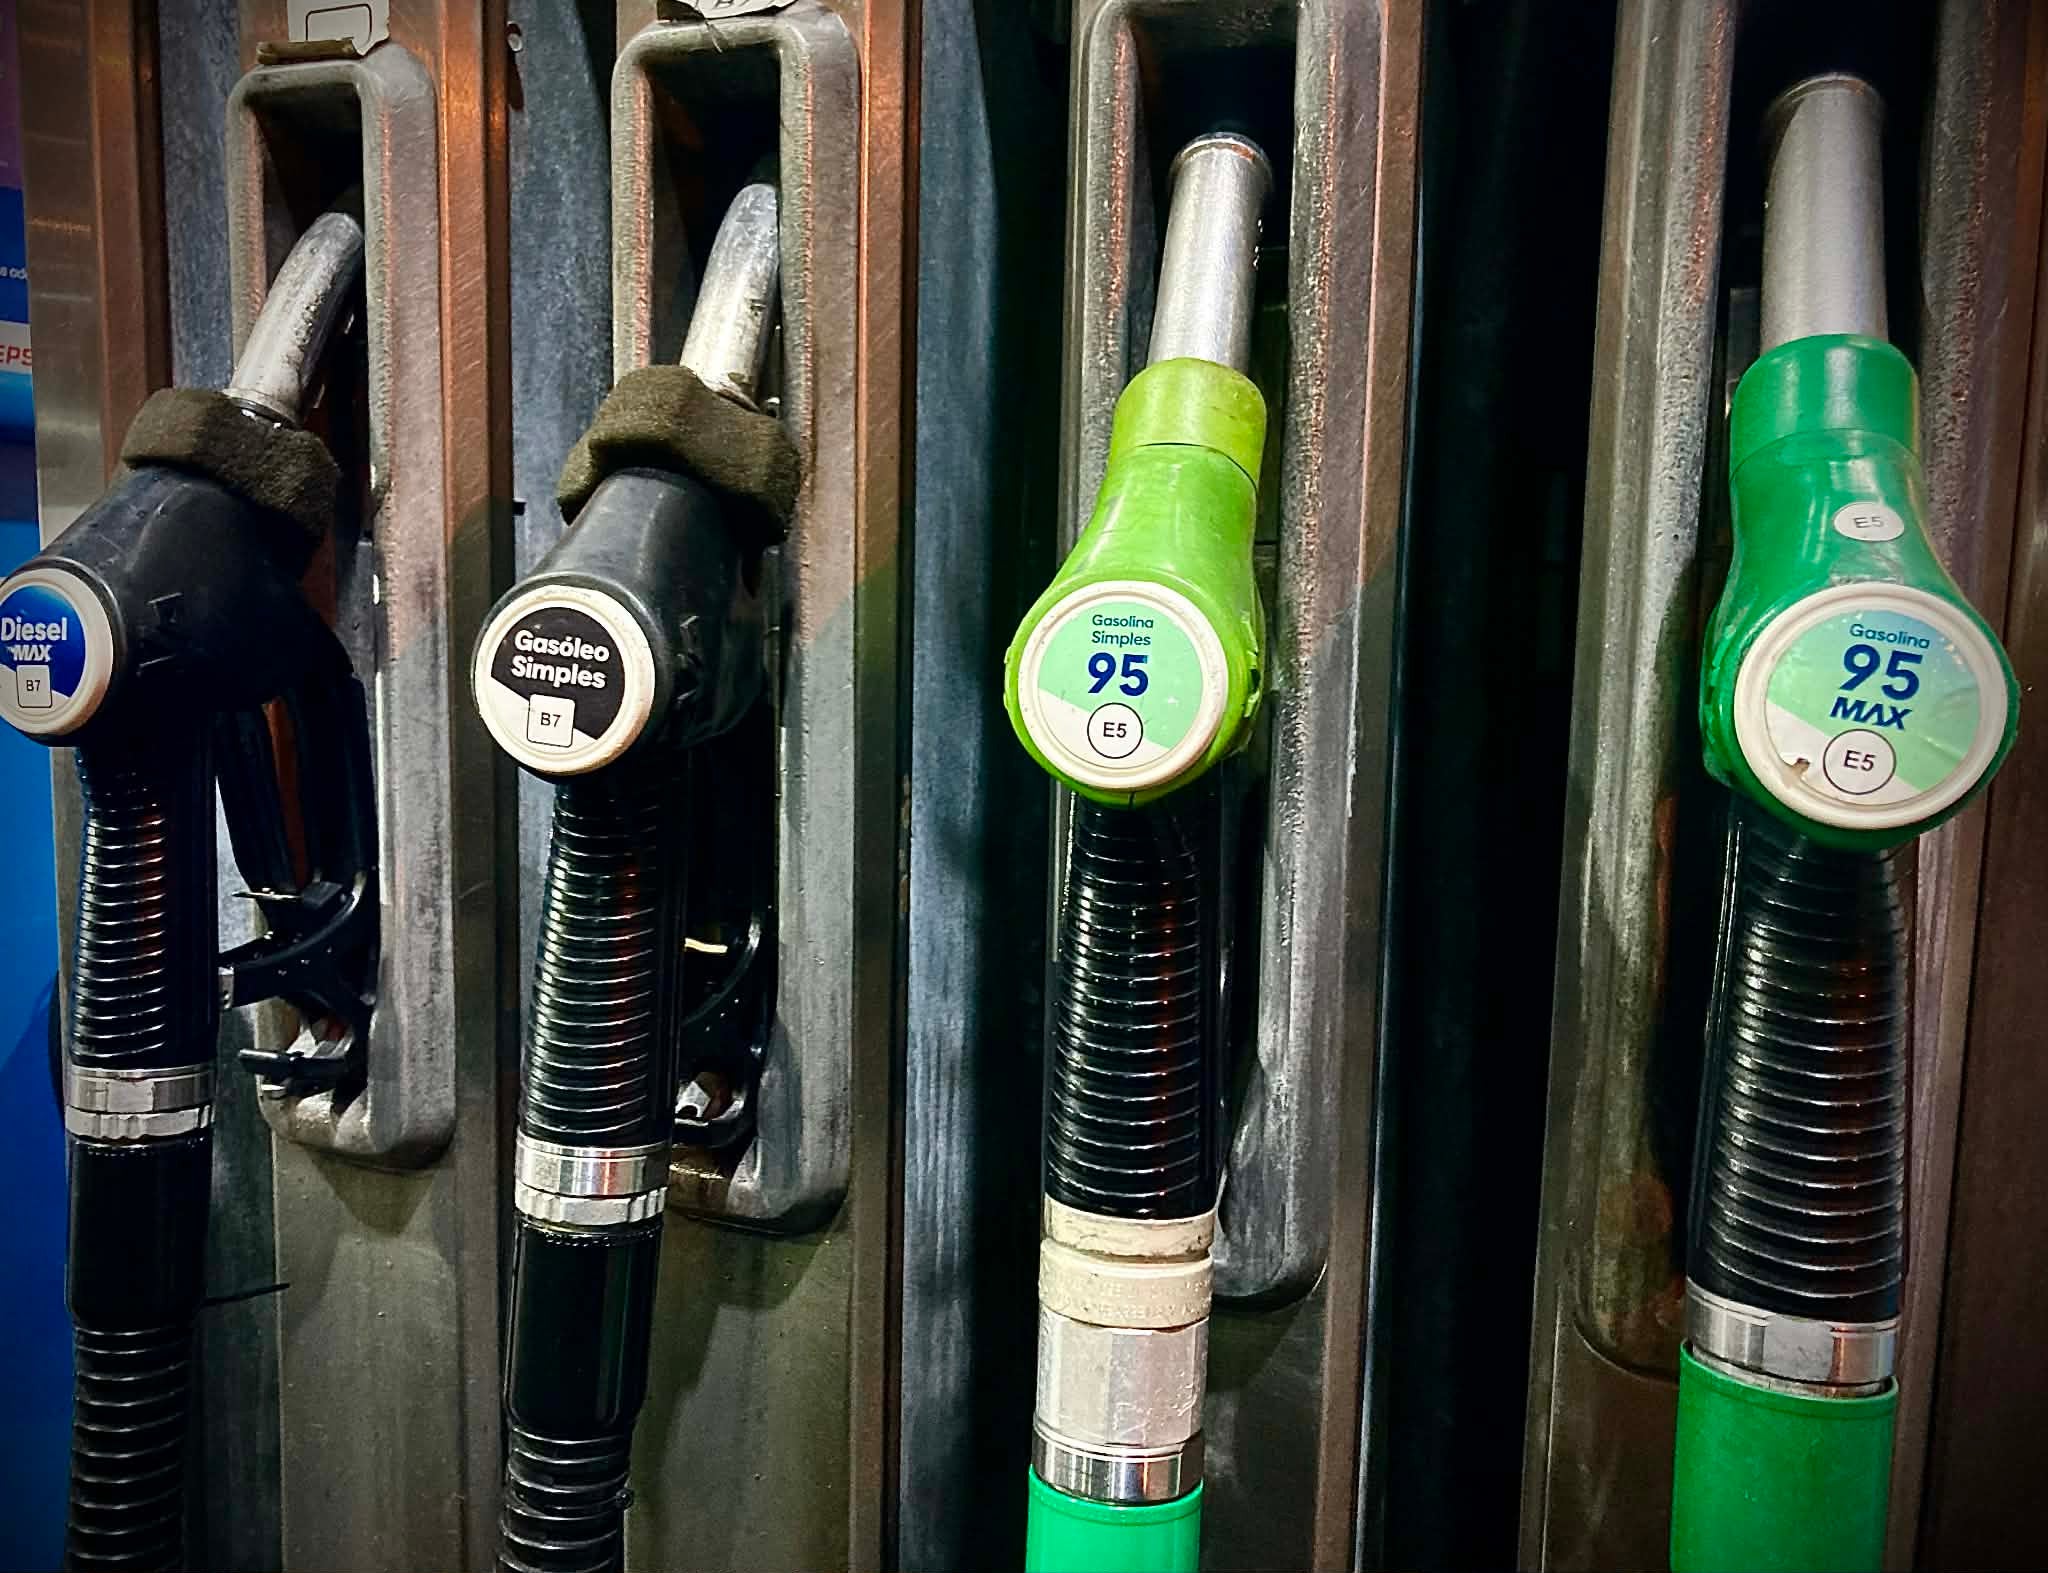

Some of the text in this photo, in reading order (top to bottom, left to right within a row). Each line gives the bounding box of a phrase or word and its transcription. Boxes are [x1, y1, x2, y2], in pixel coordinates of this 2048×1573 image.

[1854, 516, 1884, 528] E5
[1, 616, 67, 641] Diesel
[1092, 614, 1154, 629] Gasolina
[514, 629, 610, 662] Gasóleo
[1091, 630, 1151, 648] Simples
[1849, 623, 1930, 649] Gasolina
[12, 644, 52, 662] MAX
[511, 655, 607, 689] Simples
[1087, 652, 1149, 697] 95
[1839, 643, 1923, 701] 95
[26, 680, 41, 691] B7
[540, 712, 561, 728] B7
[1830, 696, 1913, 731] MAX
[1102, 721, 1127, 738] E5
[1843, 749, 1876, 772] E5
